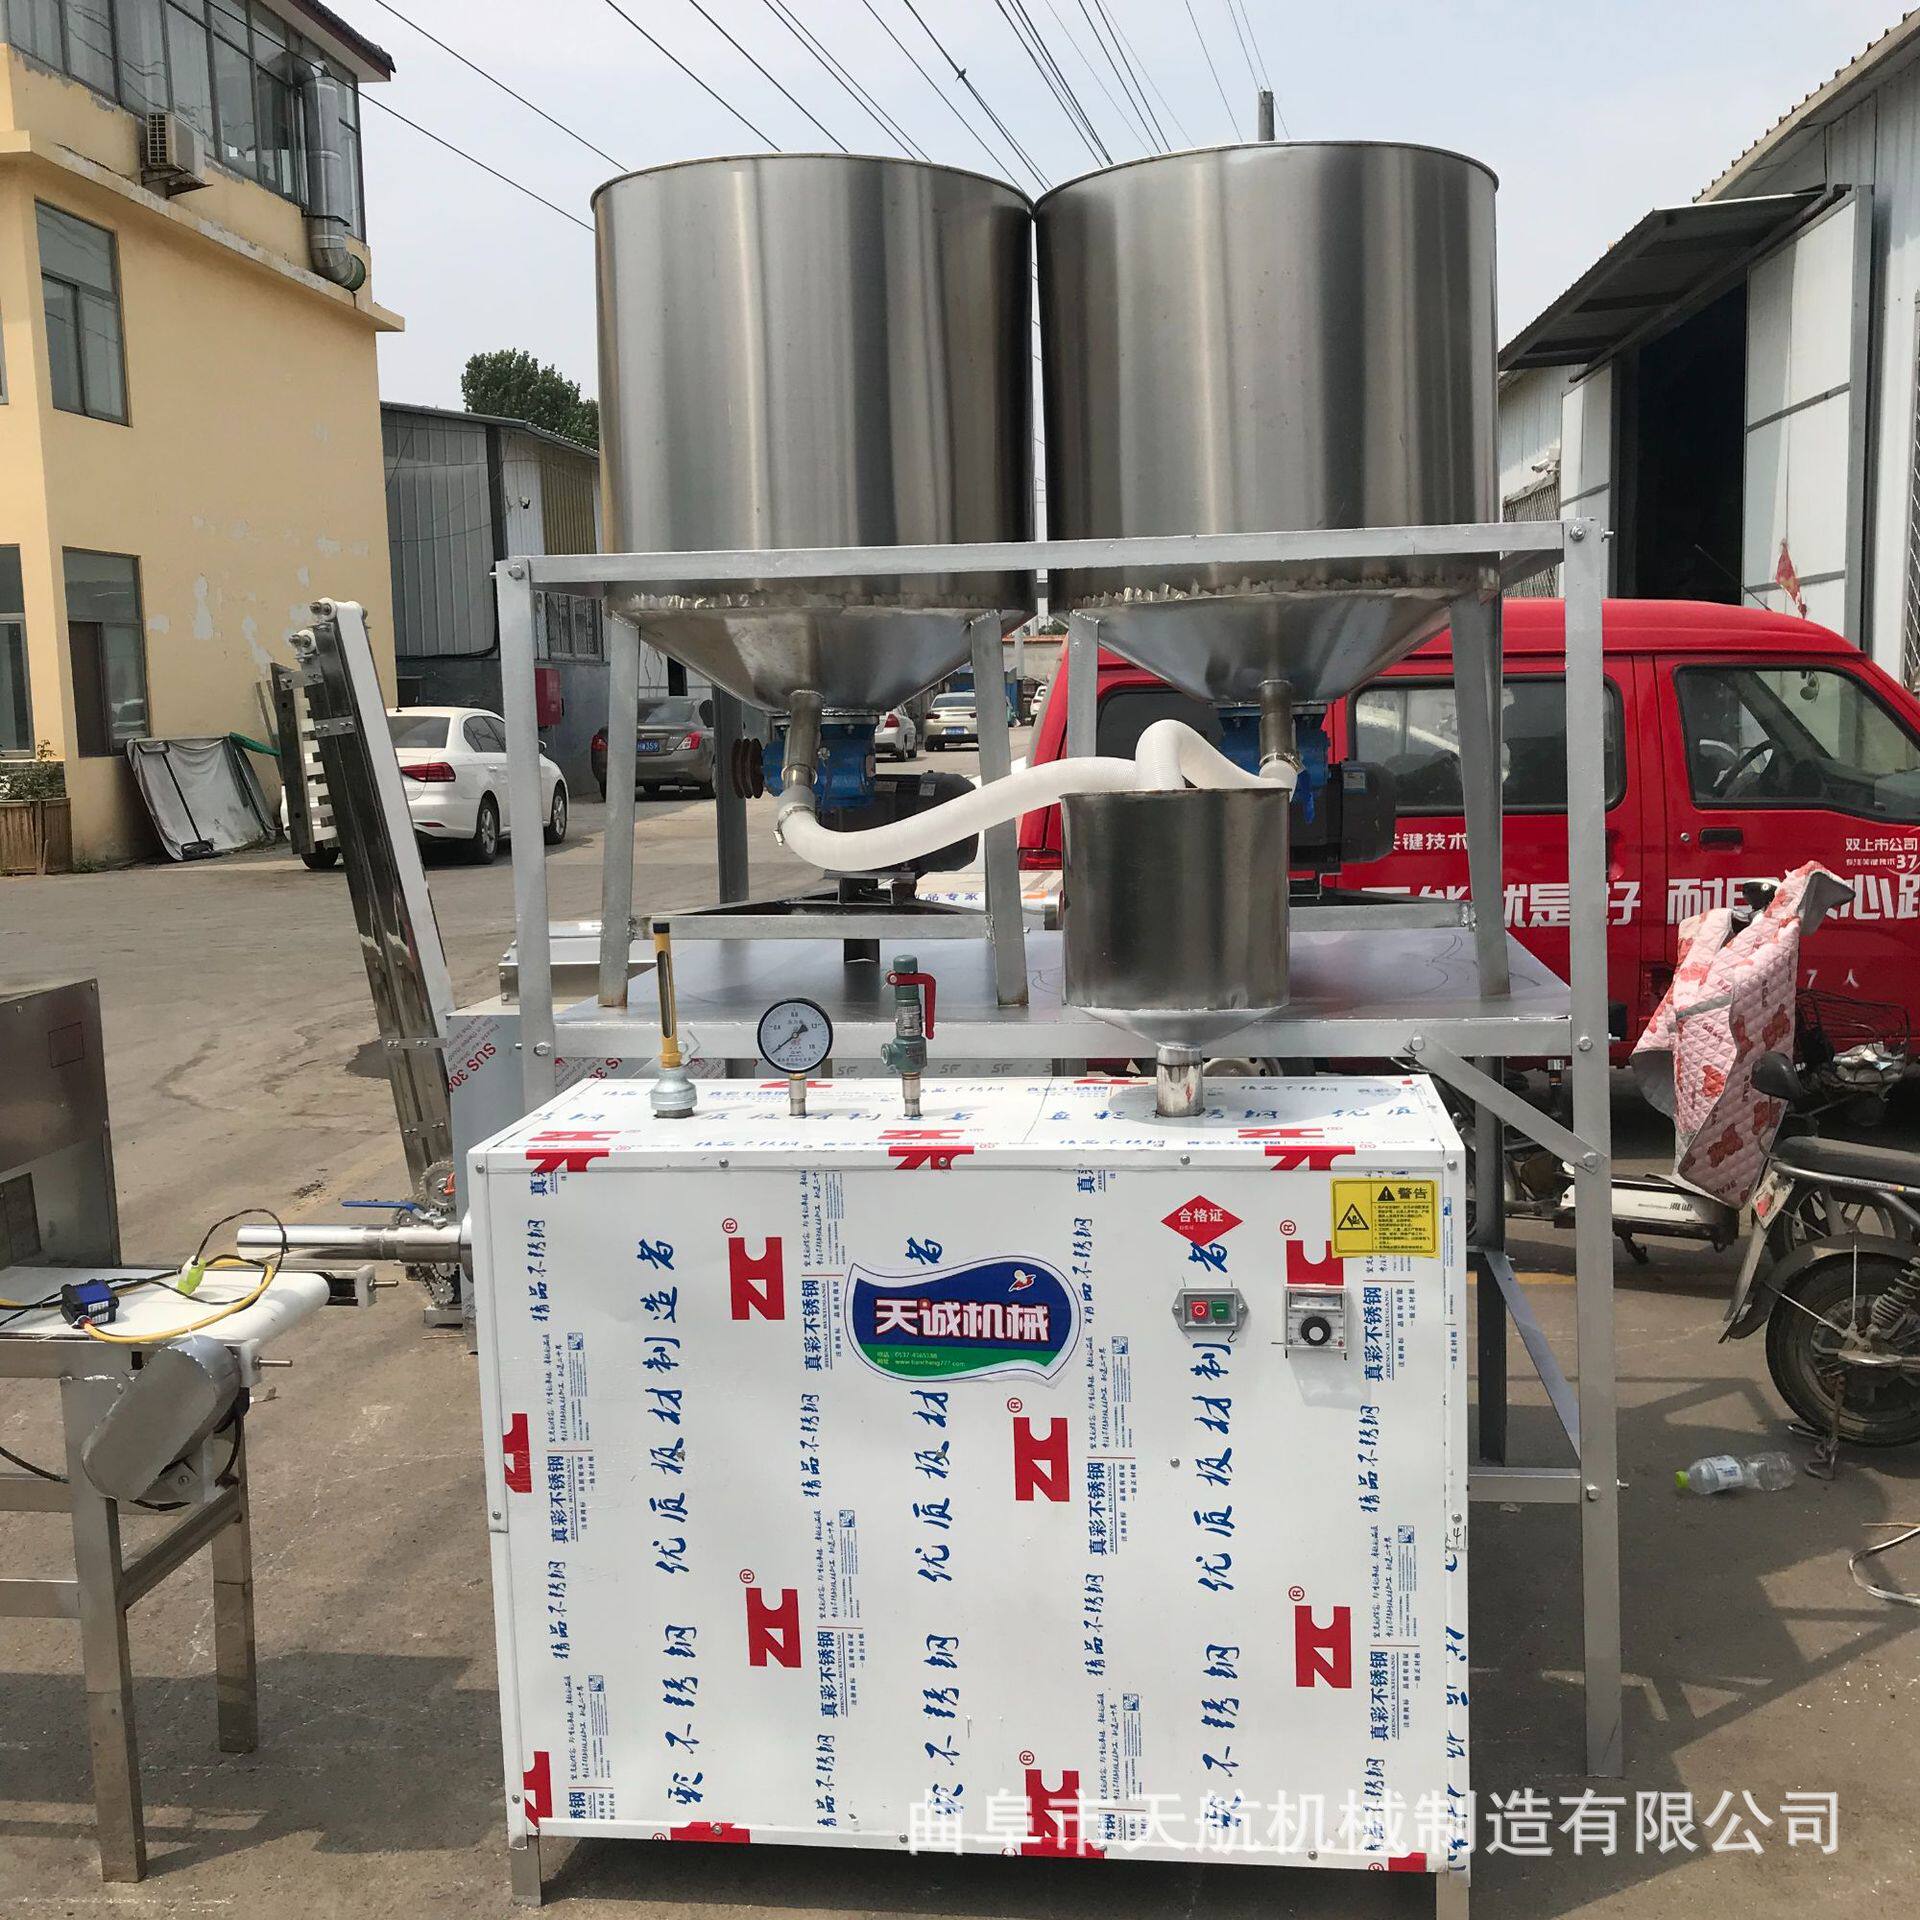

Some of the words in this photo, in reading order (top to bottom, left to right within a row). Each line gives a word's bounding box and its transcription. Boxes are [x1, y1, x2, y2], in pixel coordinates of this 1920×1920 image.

[1845, 837, 1918, 852] 双上市公司
[915, 892, 979, 902] 品专家
[466, 1042, 497, 1073] SUS
[1178, 1208, 1224, 1223] 合格证
[1397, 1186, 1428, 1200] 警告
[801, 1279, 823, 1372] 真彩不锈钢
[876, 1298, 1049, 1342] 天诚机械
[1363, 1285, 1385, 1383] 真彩不锈钢
[1188, 1242, 1237, 1592] 优质板材制者
[547, 1455, 569, 1544] 真彩不锈钢
[1086, 1462, 1109, 1556] 真彩不锈钢
[816, 1631, 839, 1719] 真彩不锈钢
[1368, 1650, 1390, 1742] 真彩不锈钢
